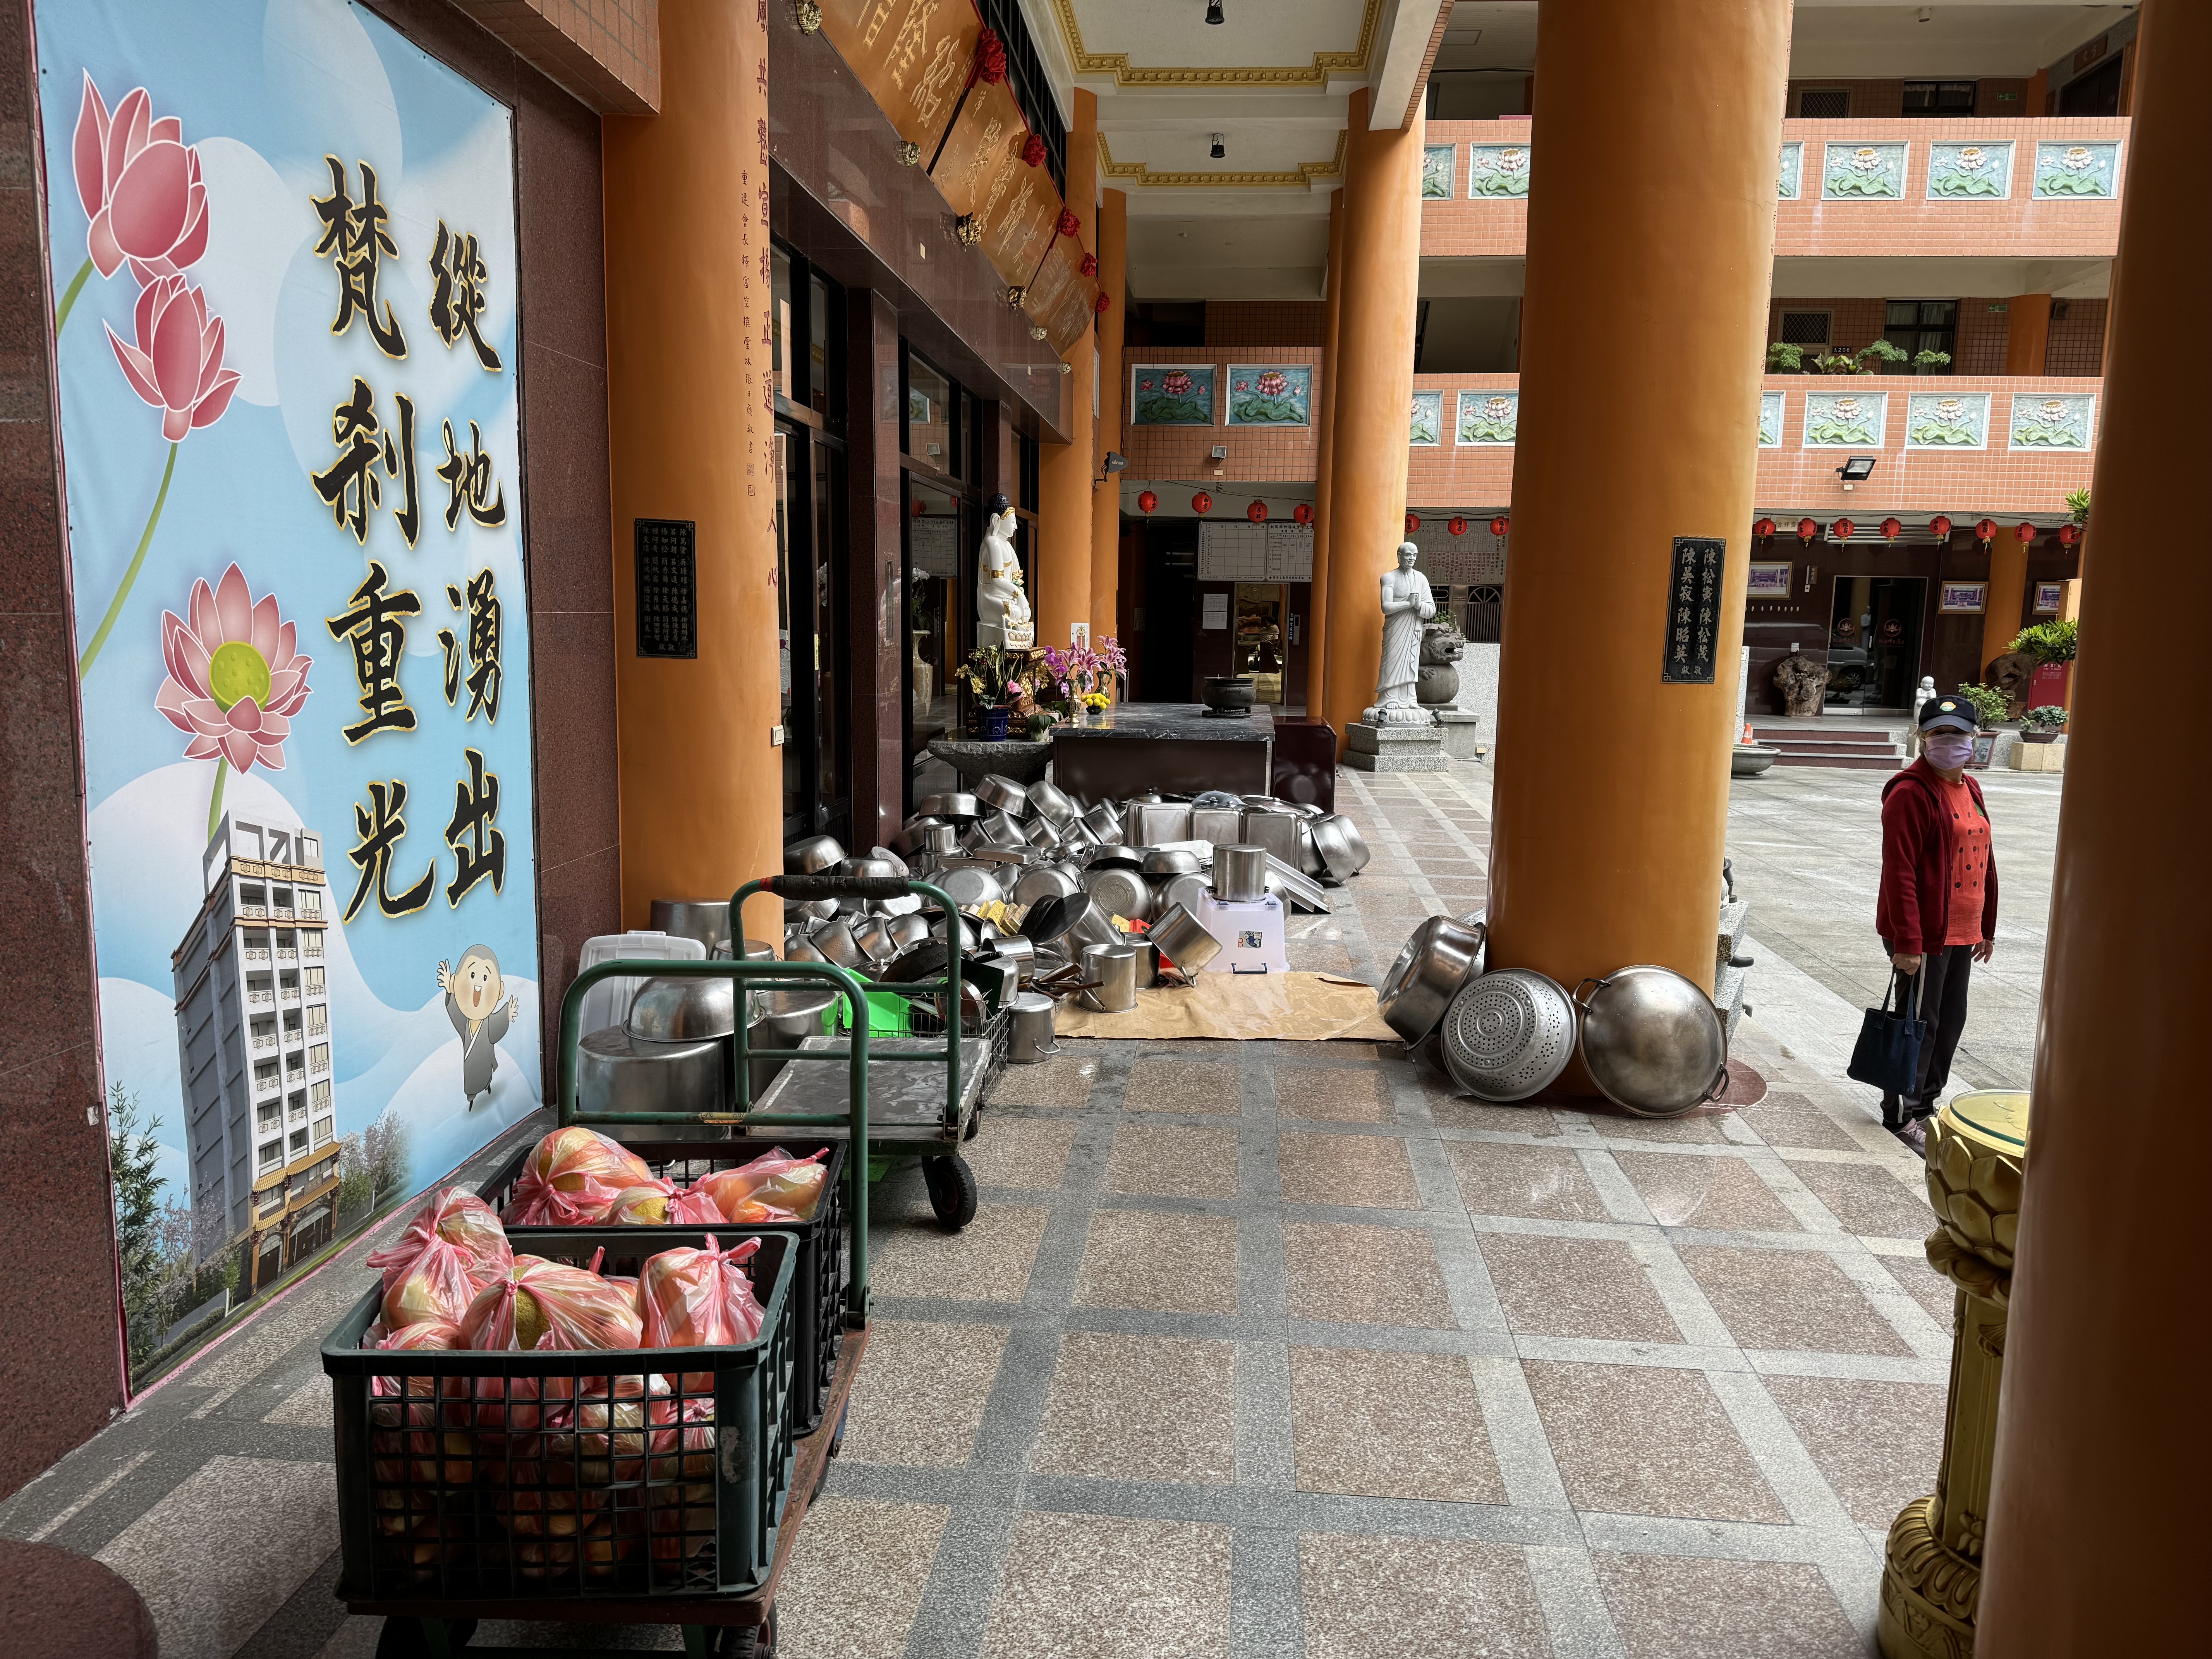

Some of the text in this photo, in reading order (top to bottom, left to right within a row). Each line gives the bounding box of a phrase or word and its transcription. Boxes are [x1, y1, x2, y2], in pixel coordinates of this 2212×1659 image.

[428, 216, 507, 910] 從地湧出
[1674, 606, 1692, 663] 陳昭英
[1681, 665, 1702, 675] 敬獻
